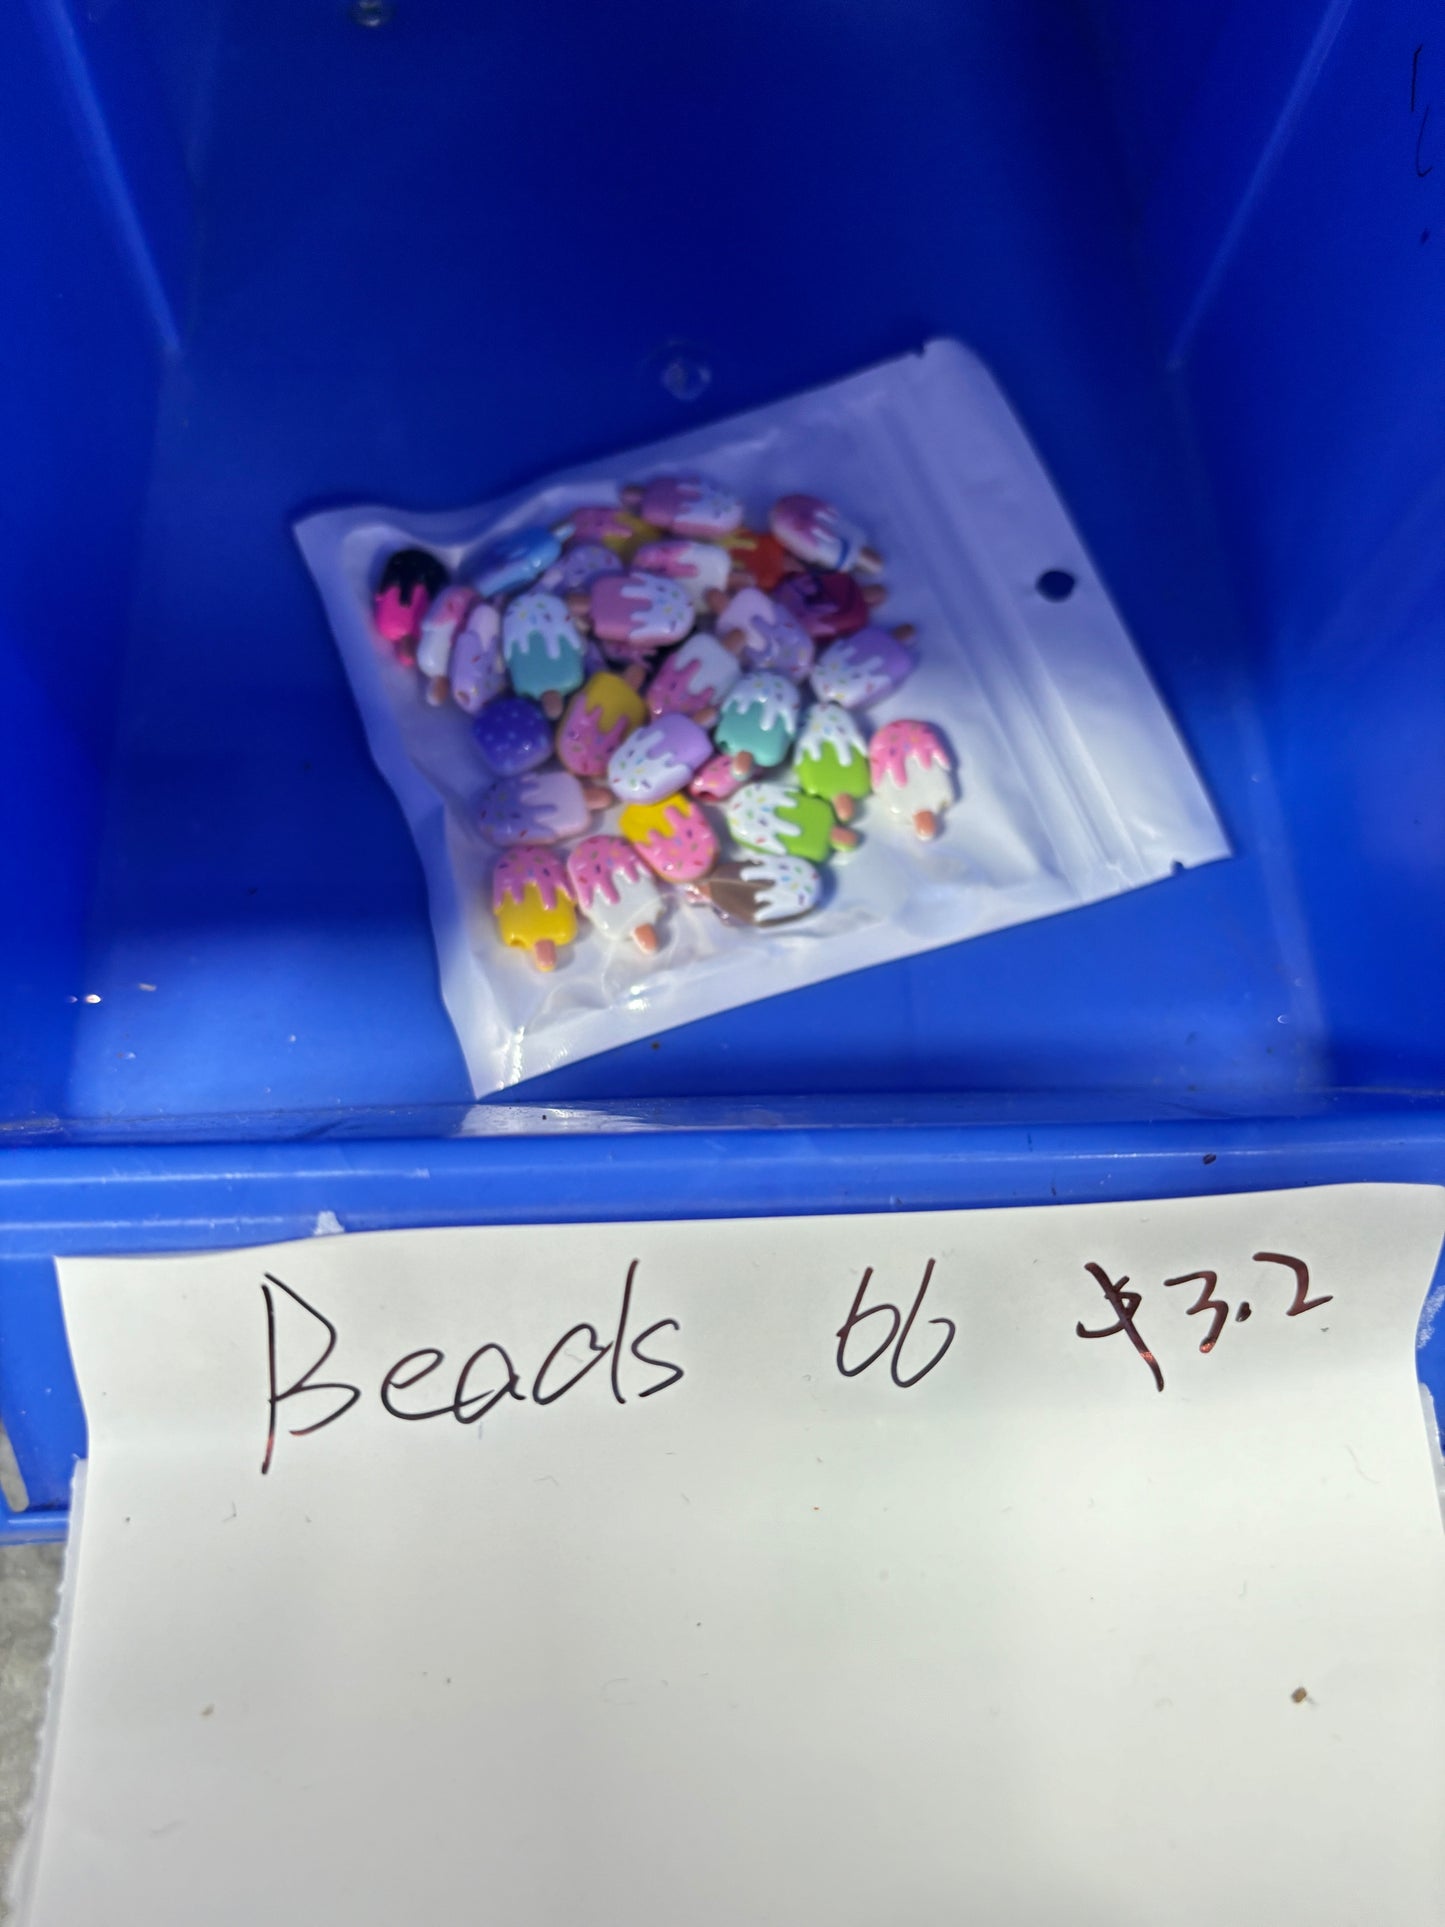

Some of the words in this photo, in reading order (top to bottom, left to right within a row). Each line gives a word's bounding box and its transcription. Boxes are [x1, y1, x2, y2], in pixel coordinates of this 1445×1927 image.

[260, 1259, 684, 1475] Beads
[836, 1258, 956, 1388] 66
[1076, 1252, 1334, 1393] $3.2
